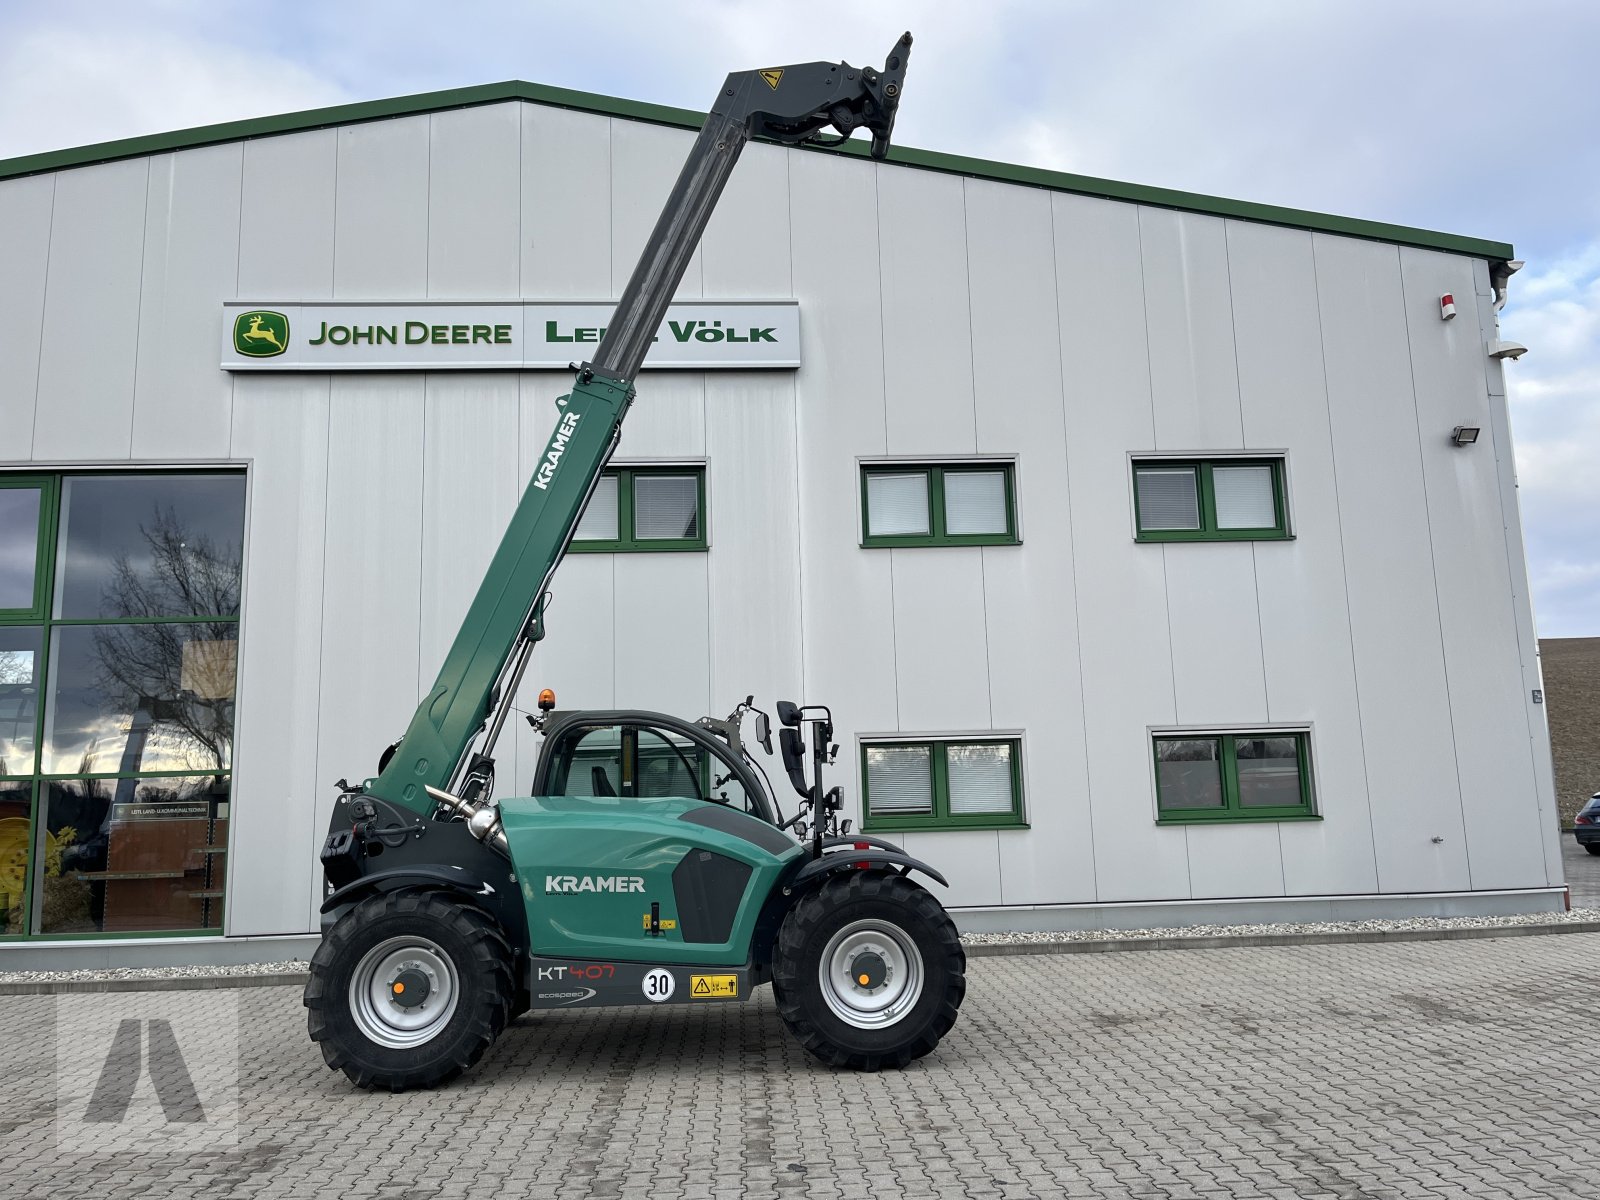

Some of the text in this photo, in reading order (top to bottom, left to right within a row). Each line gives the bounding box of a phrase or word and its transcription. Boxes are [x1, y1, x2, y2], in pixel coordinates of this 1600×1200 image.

[309, 321, 512, 346] JOHN DEERE
[668, 321, 779, 343] VÖLK
[533, 412, 580, 490] KRAMER
[545, 875, 646, 893] KRAMER
[538, 991, 584, 999] ecospeed
[648, 974, 669, 996] 30
